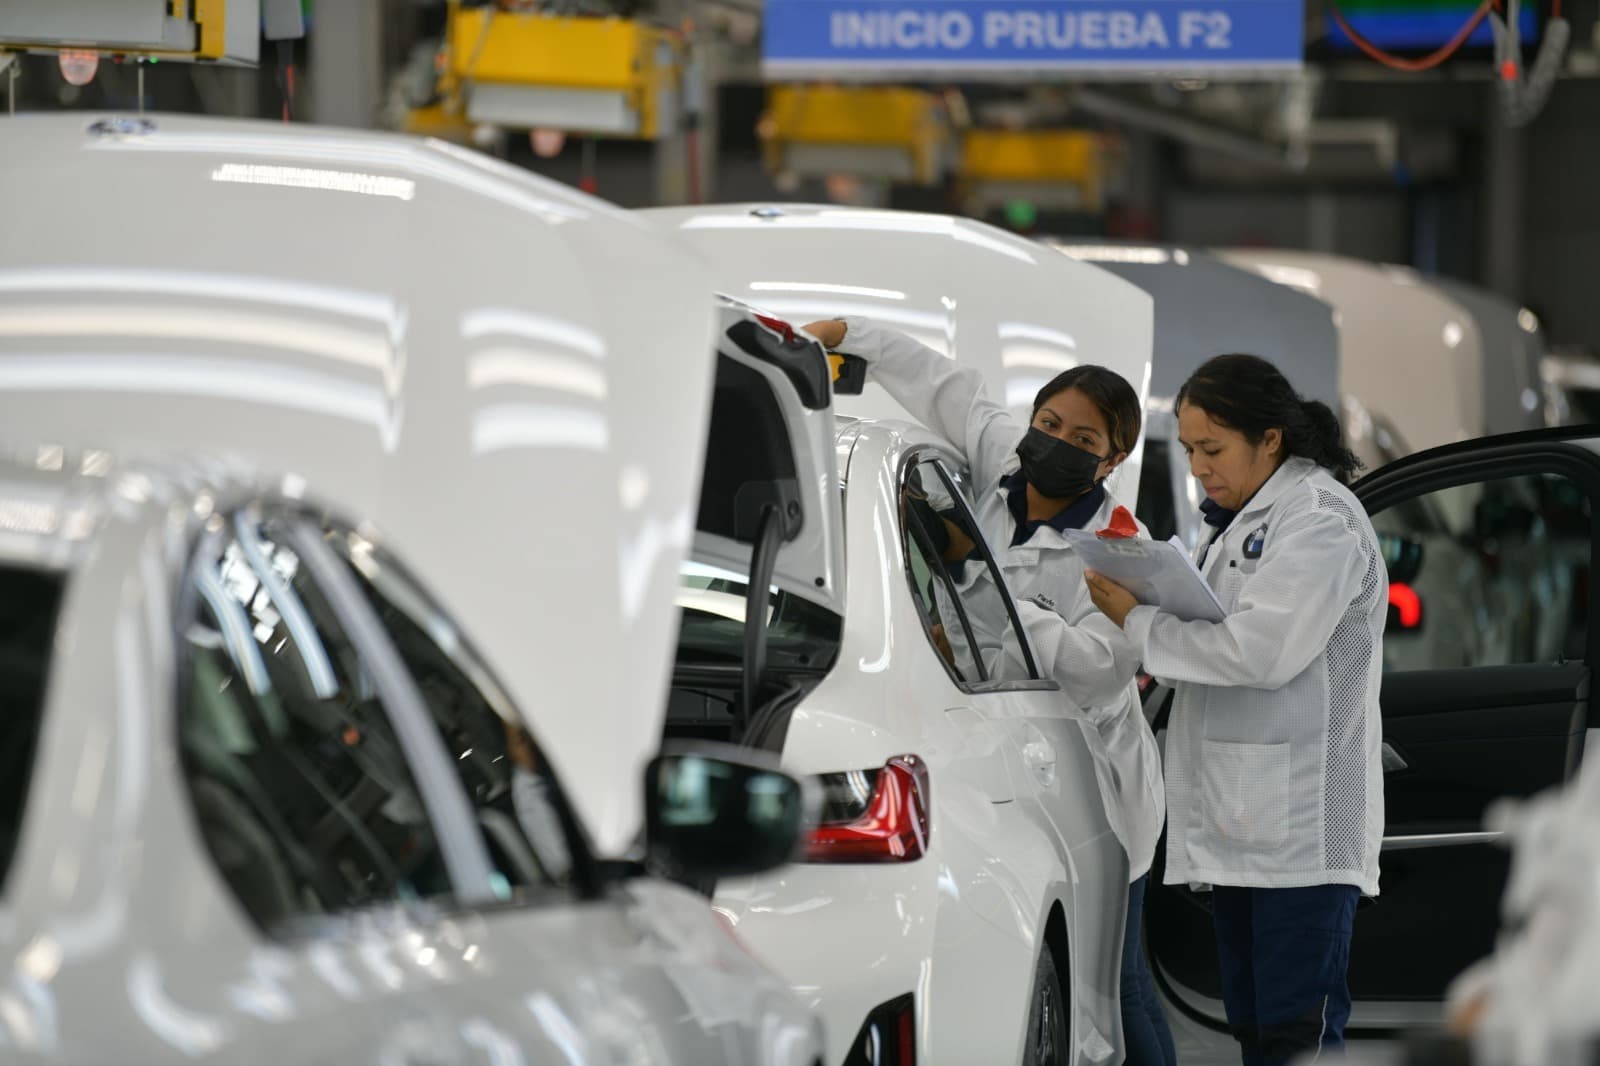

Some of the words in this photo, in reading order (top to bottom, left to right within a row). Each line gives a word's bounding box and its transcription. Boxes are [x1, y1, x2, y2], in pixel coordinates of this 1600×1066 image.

[831, 11, 971, 48] INICIO
[985, 12, 1167, 48] PRUEBA
[1180, 12, 1230, 48] F2
